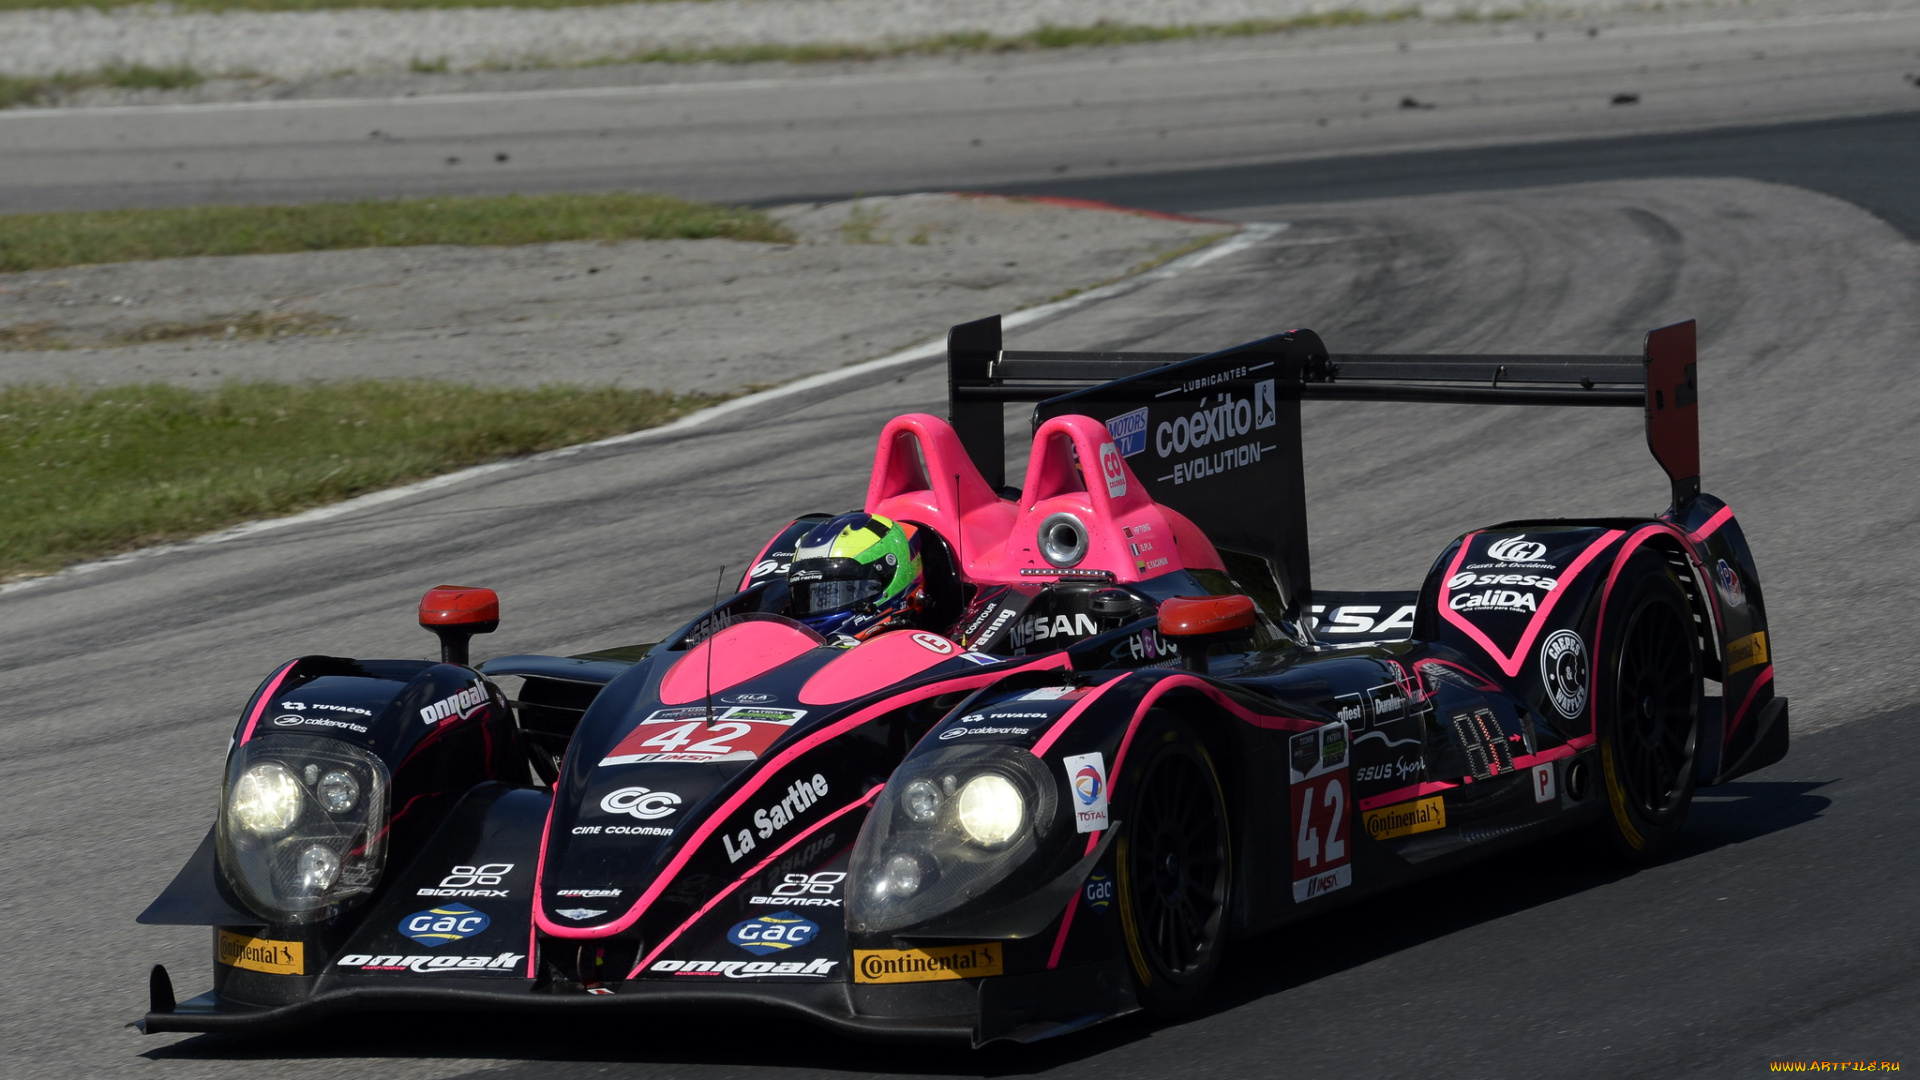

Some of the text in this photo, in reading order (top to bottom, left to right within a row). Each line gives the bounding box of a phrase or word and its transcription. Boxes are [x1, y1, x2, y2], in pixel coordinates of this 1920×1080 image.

[1183, 366, 1247, 393] LUBRICANTES
[1109, 411, 1146, 438] MOTORS
[1156, 393, 1252, 458] coéxito
[1120, 435, 1133, 454] TV
[1174, 441, 1261, 485] EVOLUTION
[1466, 562, 1493, 570] Gases
[1509, 562, 1557, 570] Occidente
[1473, 574, 1558, 591] siesa
[1449, 590, 1537, 612] CaliDA
[965, 602, 997, 635] CONTOUR
[967, 608, 1017, 653] racing
[1010, 613, 1098, 650] NISSAN
[1548, 636, 1581, 660] CREPES
[1565, 666, 1573, 681] &
[312, 703, 372, 716] TUVACOL
[304, 717, 368, 734] coldeportes
[641, 721, 752, 754] 42
[967, 726, 1029, 735] coldeportes
[1539, 770, 1549, 797] P
[722, 773, 829, 864] La Sarthe
[1078, 811, 1106, 822] TOTAL
[1297, 779, 1345, 868] 42
[1366, 804, 1431, 836] Continental
[572, 826, 674, 837] CINE COLOMBIA
[416, 888, 511, 898] BIOMAX
[749, 896, 843, 907] BIOMAX
[220, 936, 279, 965] Continental
[860, 950, 978, 979] Continental
